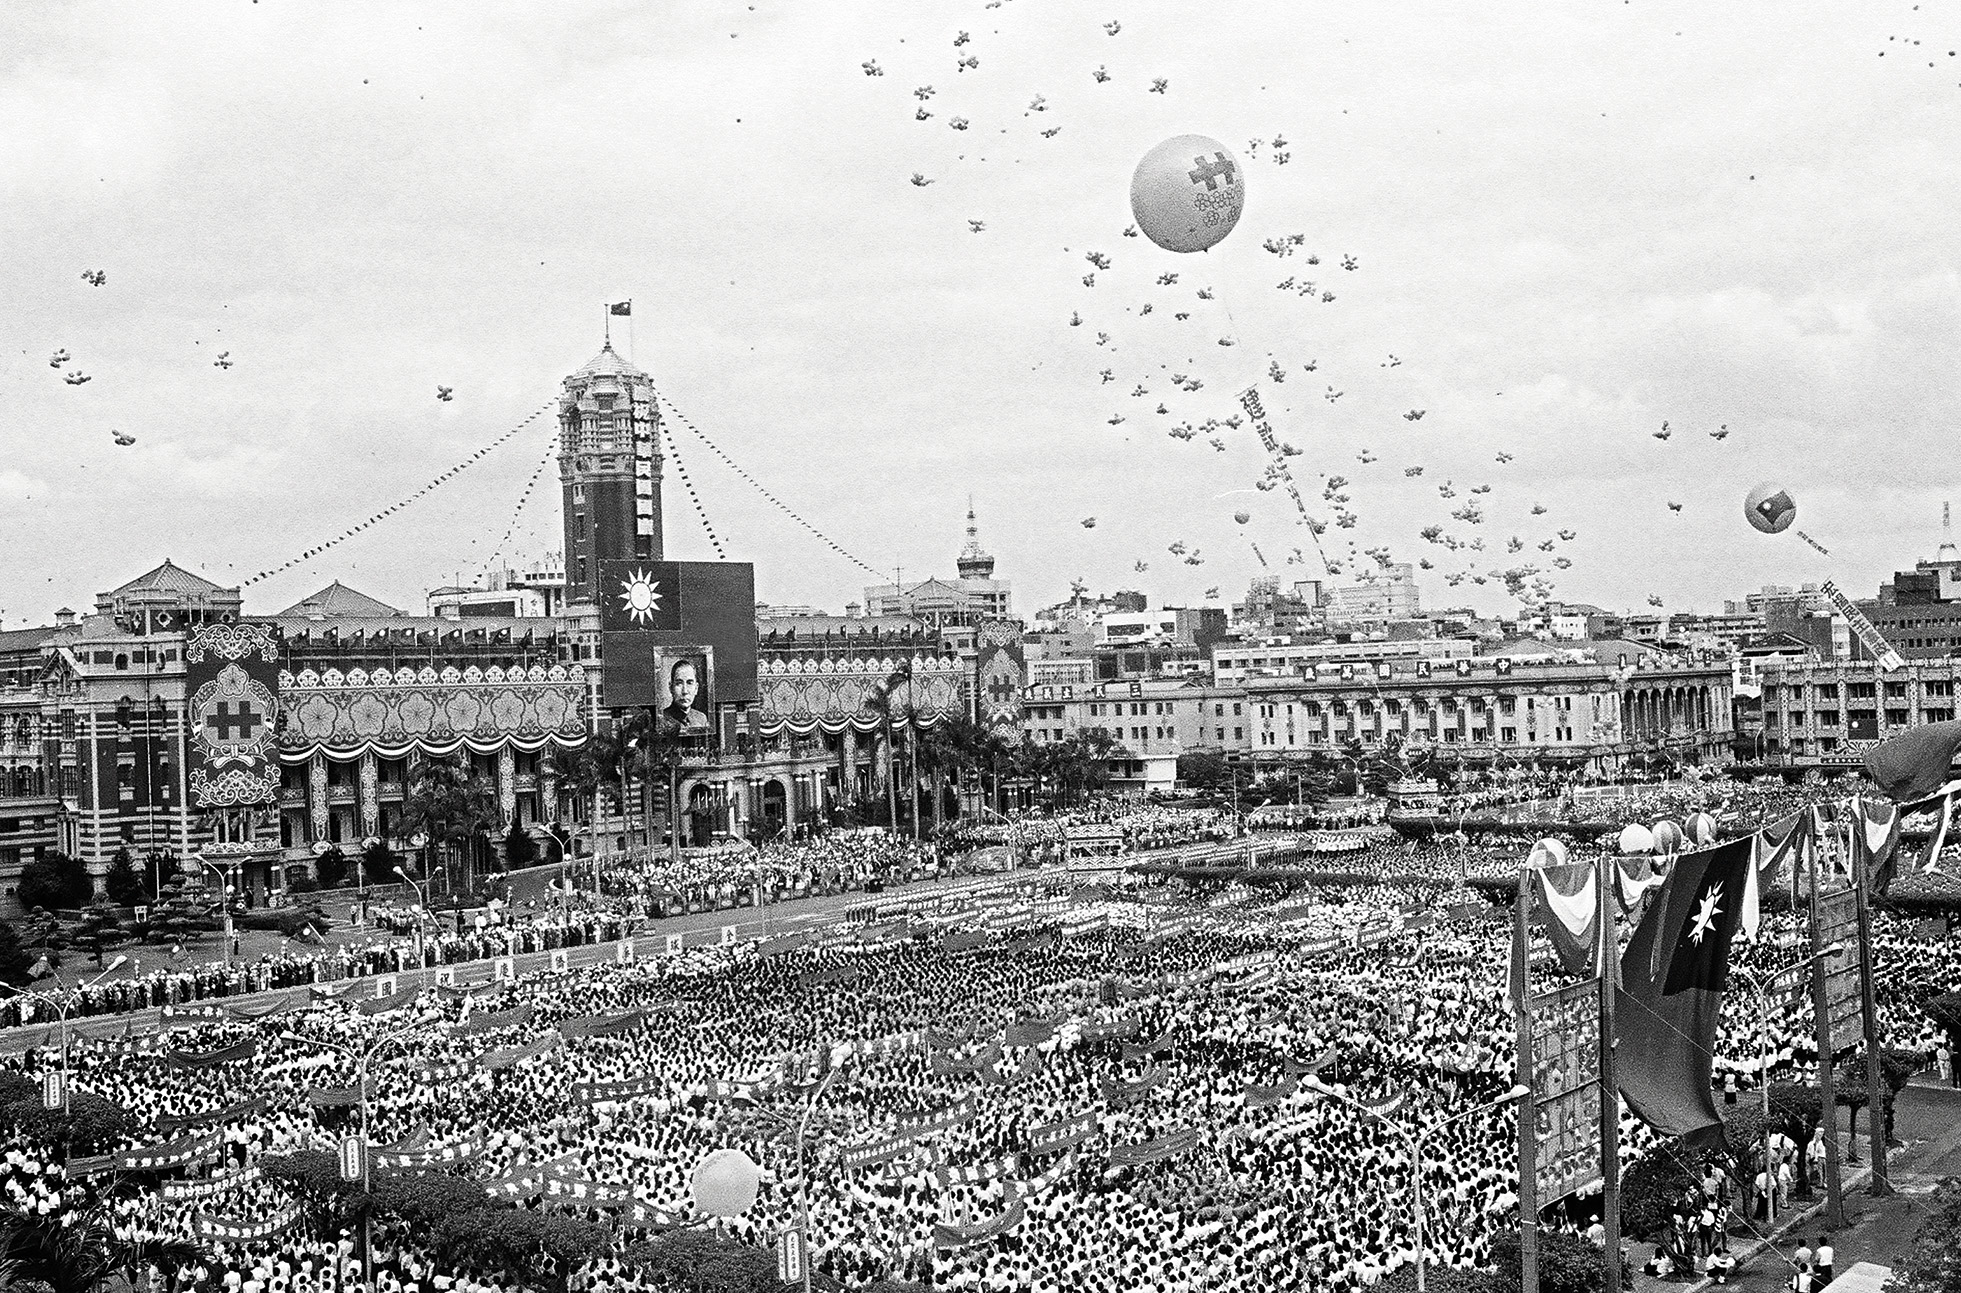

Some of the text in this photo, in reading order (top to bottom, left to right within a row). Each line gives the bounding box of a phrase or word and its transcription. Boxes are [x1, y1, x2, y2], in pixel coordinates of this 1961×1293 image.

[1820, 580, 1891, 658] 宏揚民主憲政
